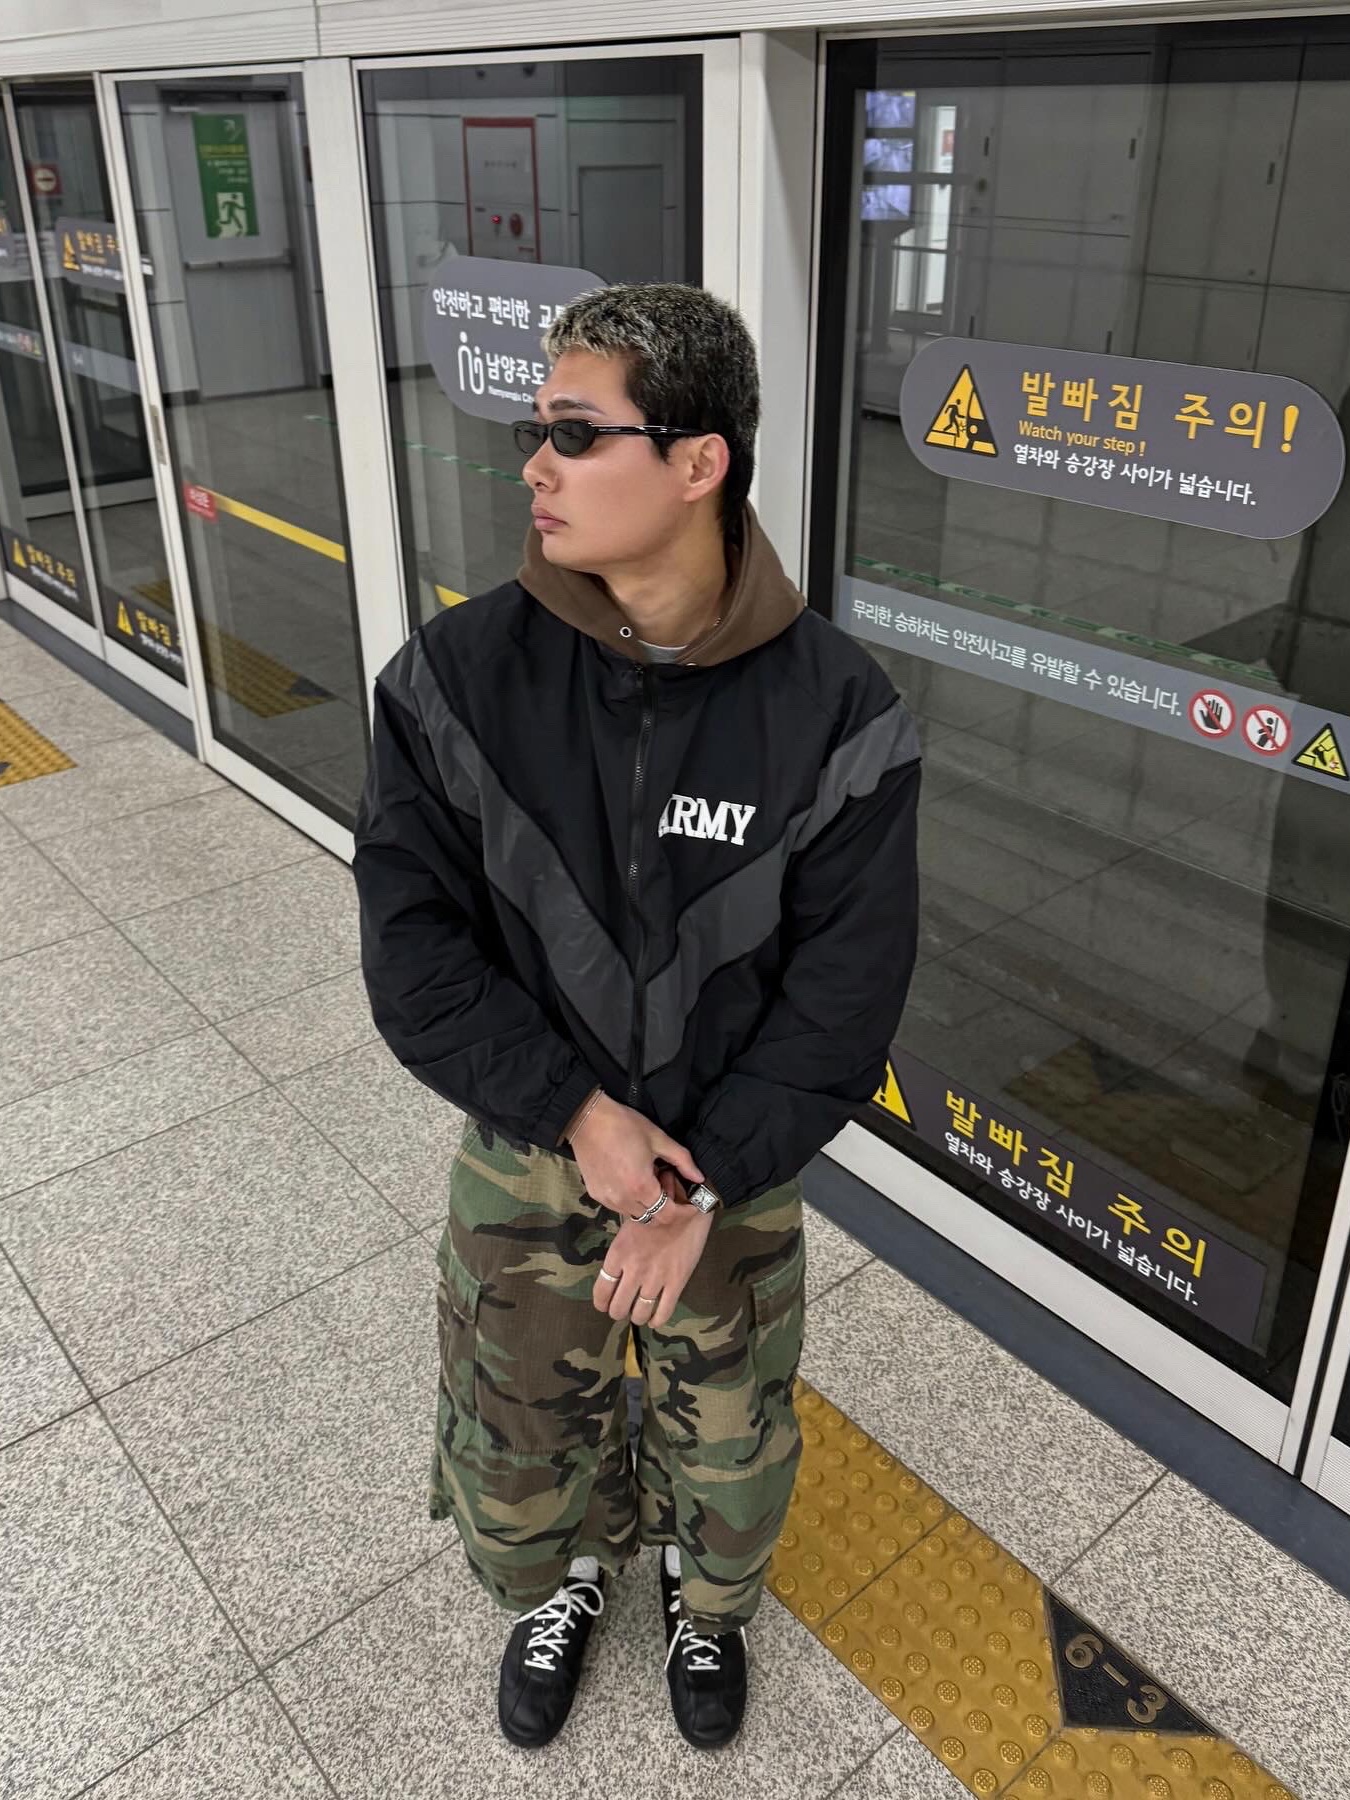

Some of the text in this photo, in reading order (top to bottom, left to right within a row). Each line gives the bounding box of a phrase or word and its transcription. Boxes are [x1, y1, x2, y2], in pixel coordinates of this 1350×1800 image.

[432, 288, 486, 319] 안전하고
[488, 296, 531, 330] 편리한
[486, 352, 552, 386] 남양주도
[1021, 371, 1144, 431] 발빠짐
[1018, 420, 1062, 442] Watch
[1066, 431, 1100, 449] your
[1013, 443, 1257, 506] 열차와 승강장 사이가 넓습니다.
[851, 599, 1183, 717] 무리한 승하차는 안전사고를 유발할 수 있습니다.
[945, 1090, 1208, 1278] 발빠짐 주의
[944, 1131, 1200, 1306] 열차와 승강장 사이가 넓습니다.
[1065, 1633, 1168, 1724] 6-3
